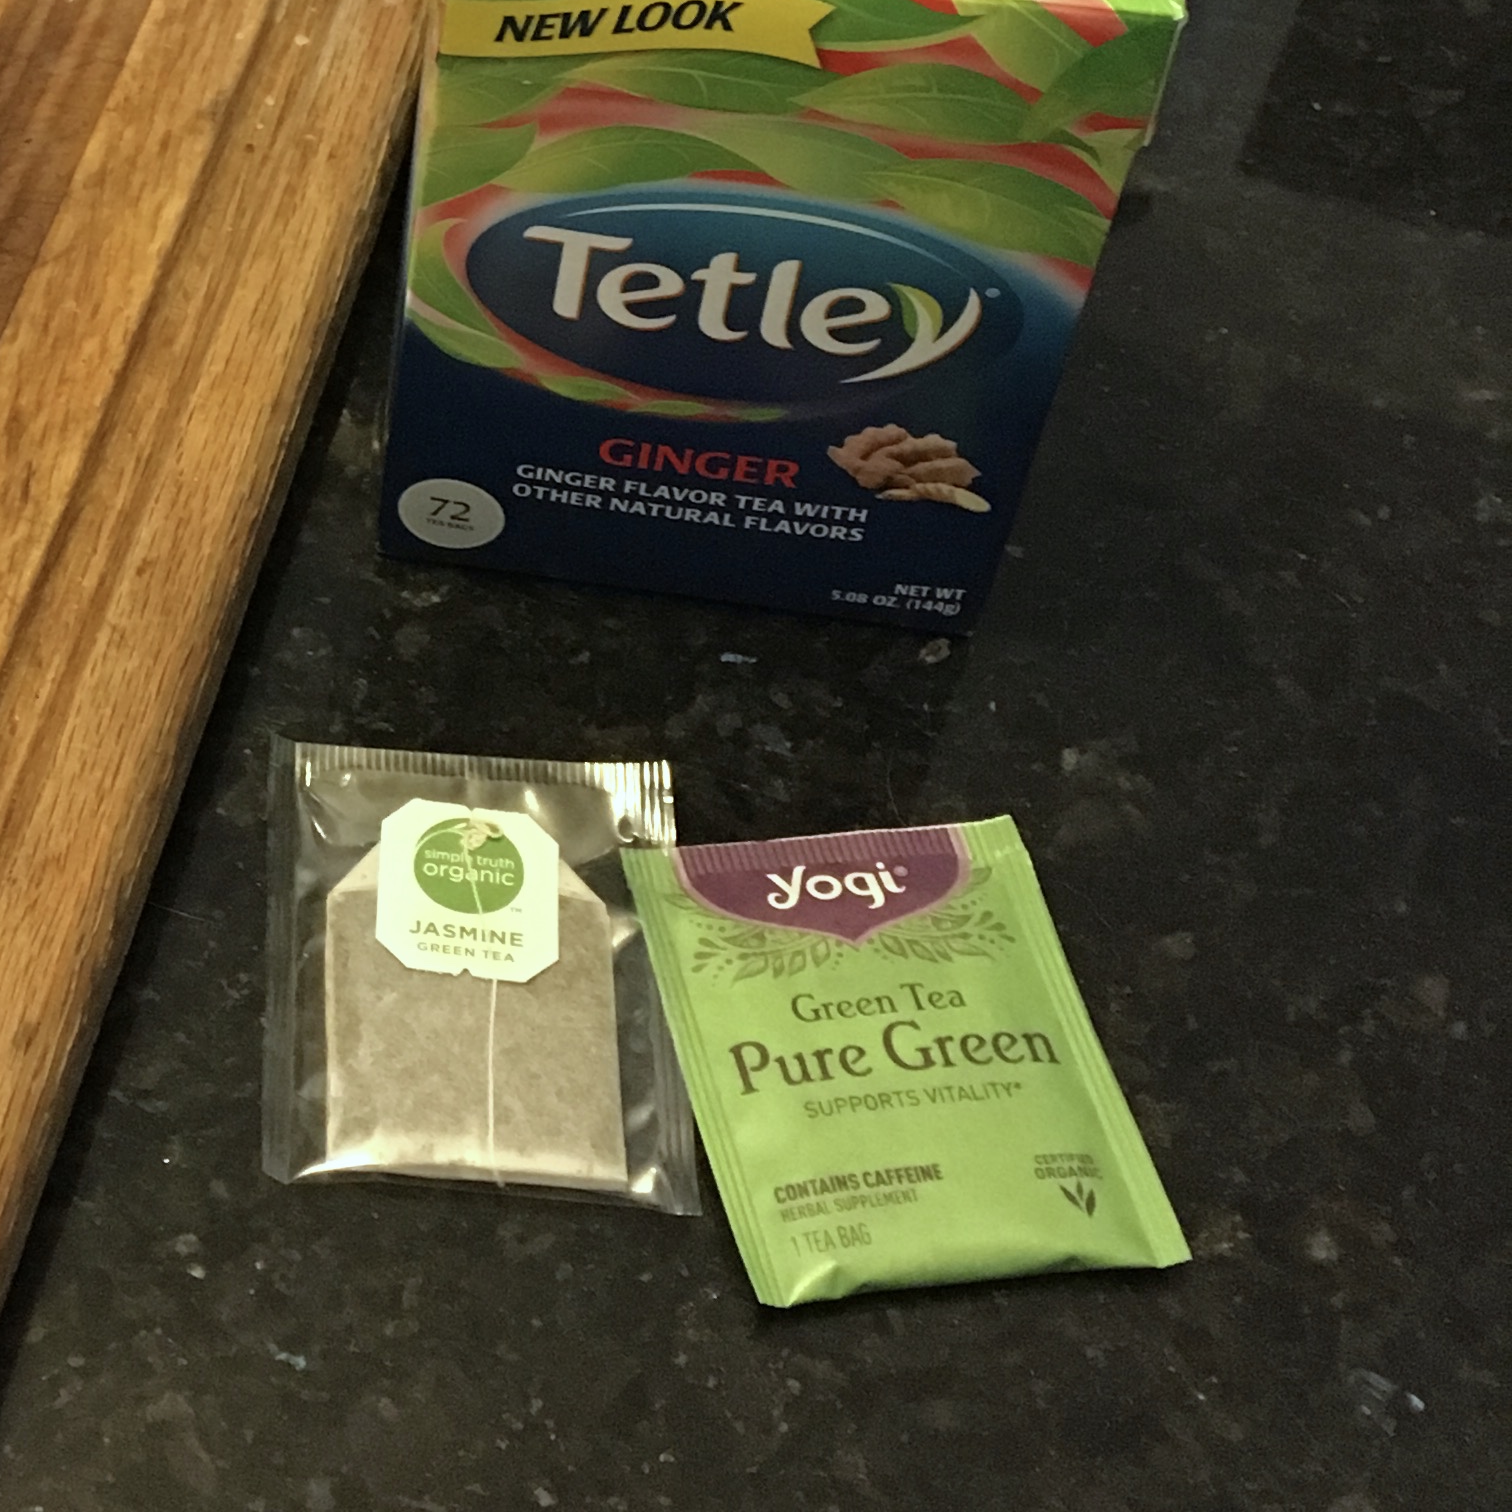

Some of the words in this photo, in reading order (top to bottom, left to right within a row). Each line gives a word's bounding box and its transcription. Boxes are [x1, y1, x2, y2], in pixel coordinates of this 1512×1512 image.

[493, 5, 609, 44] NEW
[610, 0, 744, 37] LOOK
[522, 225, 983, 384] Tetley
[598, 437, 801, 488] GINGER
[429, 496, 471, 522] 72
[512, 482, 602, 510] OTHER
[608, 496, 736, 528] NATURAL
[743, 516, 865, 543] FLAVORS
[516, 464, 617, 492] GINGER
[623, 480, 728, 508] FLAVOR
[735, 494, 786, 515] TEA
[793, 501, 869, 524] WITH
[893, 583, 931, 598] NET
[934, 587, 967, 601] WT
[905, 597, 962, 617] (144g)
[422, 862, 515, 887] organic
[476, 854, 515, 870] truth
[766, 861, 906, 910] yogi
[408, 919, 524, 948] JASMINE
[416, 941, 476, 958] GREEN
[482, 949, 515, 963] TEA
[790, 991, 896, 1024] Green
[900, 982, 968, 1013] Tea
[728, 1040, 873, 1096] Pure
[881, 1019, 1062, 1072] Green
[803, 1088, 920, 1119] SUPPORTS
[773, 1173, 862, 1205] CONTAINS
[862, 1162, 944, 1189] CAFFEINE
[780, 1199, 831, 1224] HERBAL
[833, 1187, 920, 1213] SUPPLEMENT
[790, 1235, 802, 1258] 1
[801, 1228, 837, 1254] TEA
[836, 1221, 873, 1249] BAG
